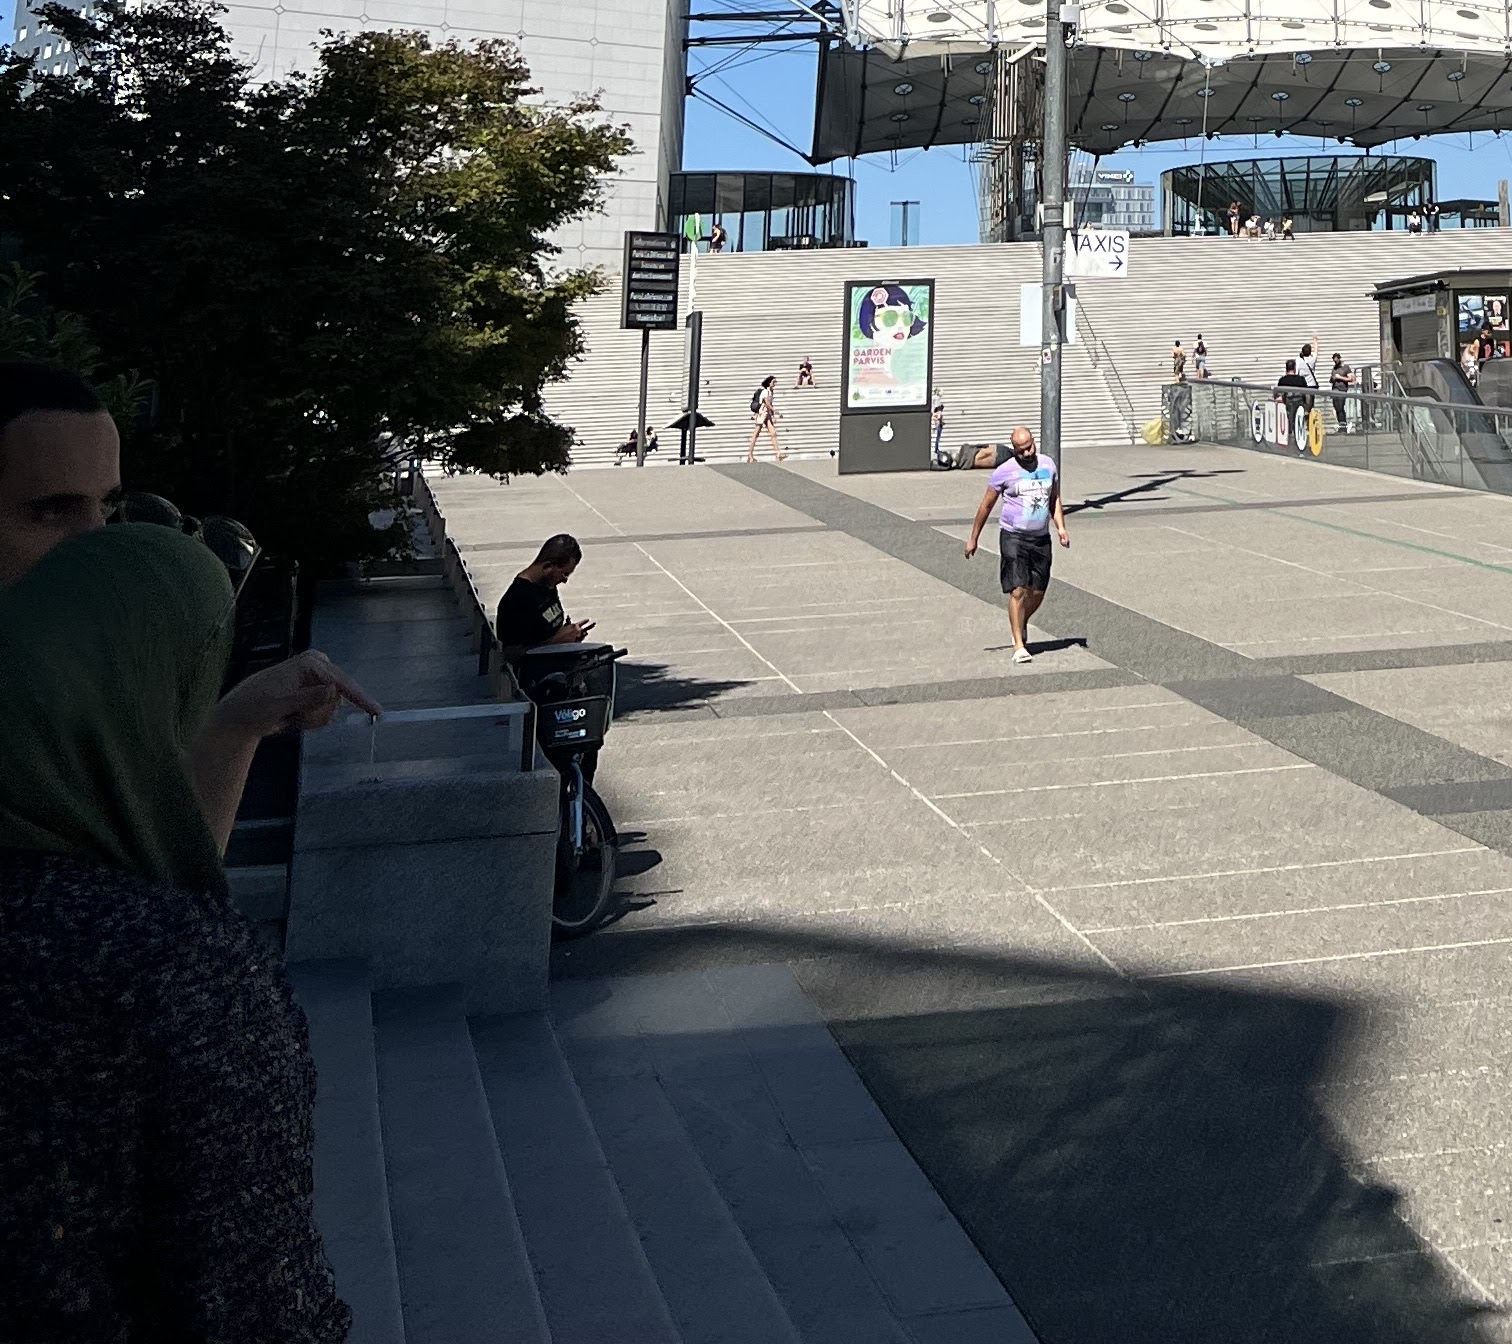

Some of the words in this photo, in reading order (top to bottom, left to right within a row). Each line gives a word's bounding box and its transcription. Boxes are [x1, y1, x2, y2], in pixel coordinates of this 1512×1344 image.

[1071, 233, 1125, 254] TAXIS
[853, 348, 892, 357] GARDEN
[853, 357, 886, 365] PARVIS
